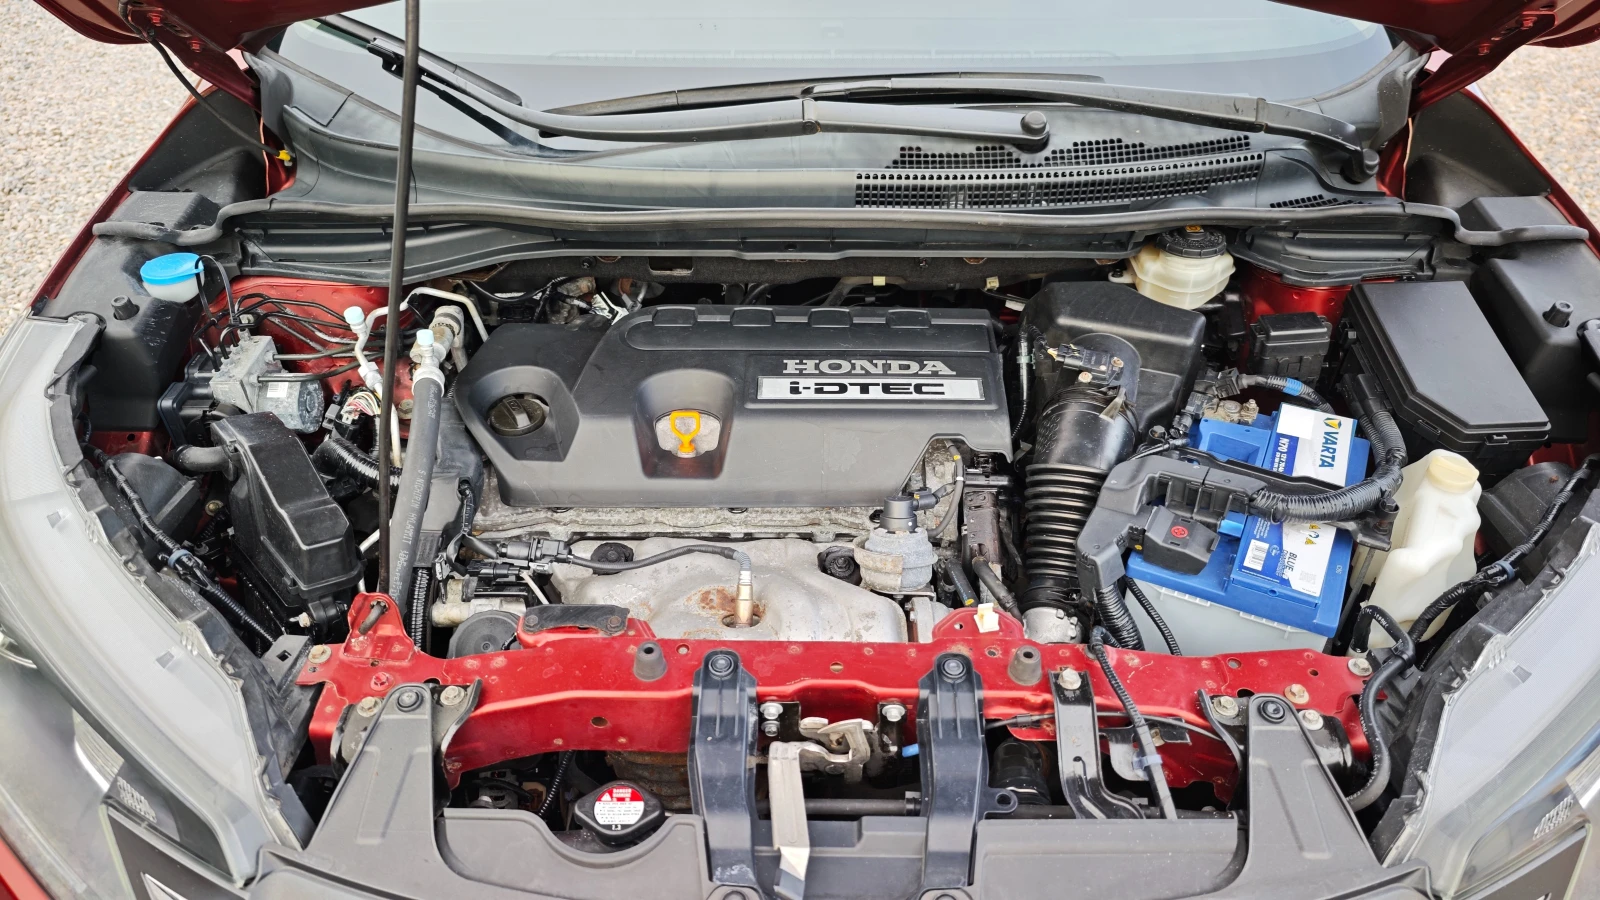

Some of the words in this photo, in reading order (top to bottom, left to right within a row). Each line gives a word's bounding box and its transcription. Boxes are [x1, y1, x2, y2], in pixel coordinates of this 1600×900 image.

[782, 359, 957, 375] HONDA
[789, 380, 946, 396] i-DTEC
[1277, 437, 1290, 453] N70
[1318, 431, 1340, 468] VARTA
[1288, 552, 1298, 573] BLUE
